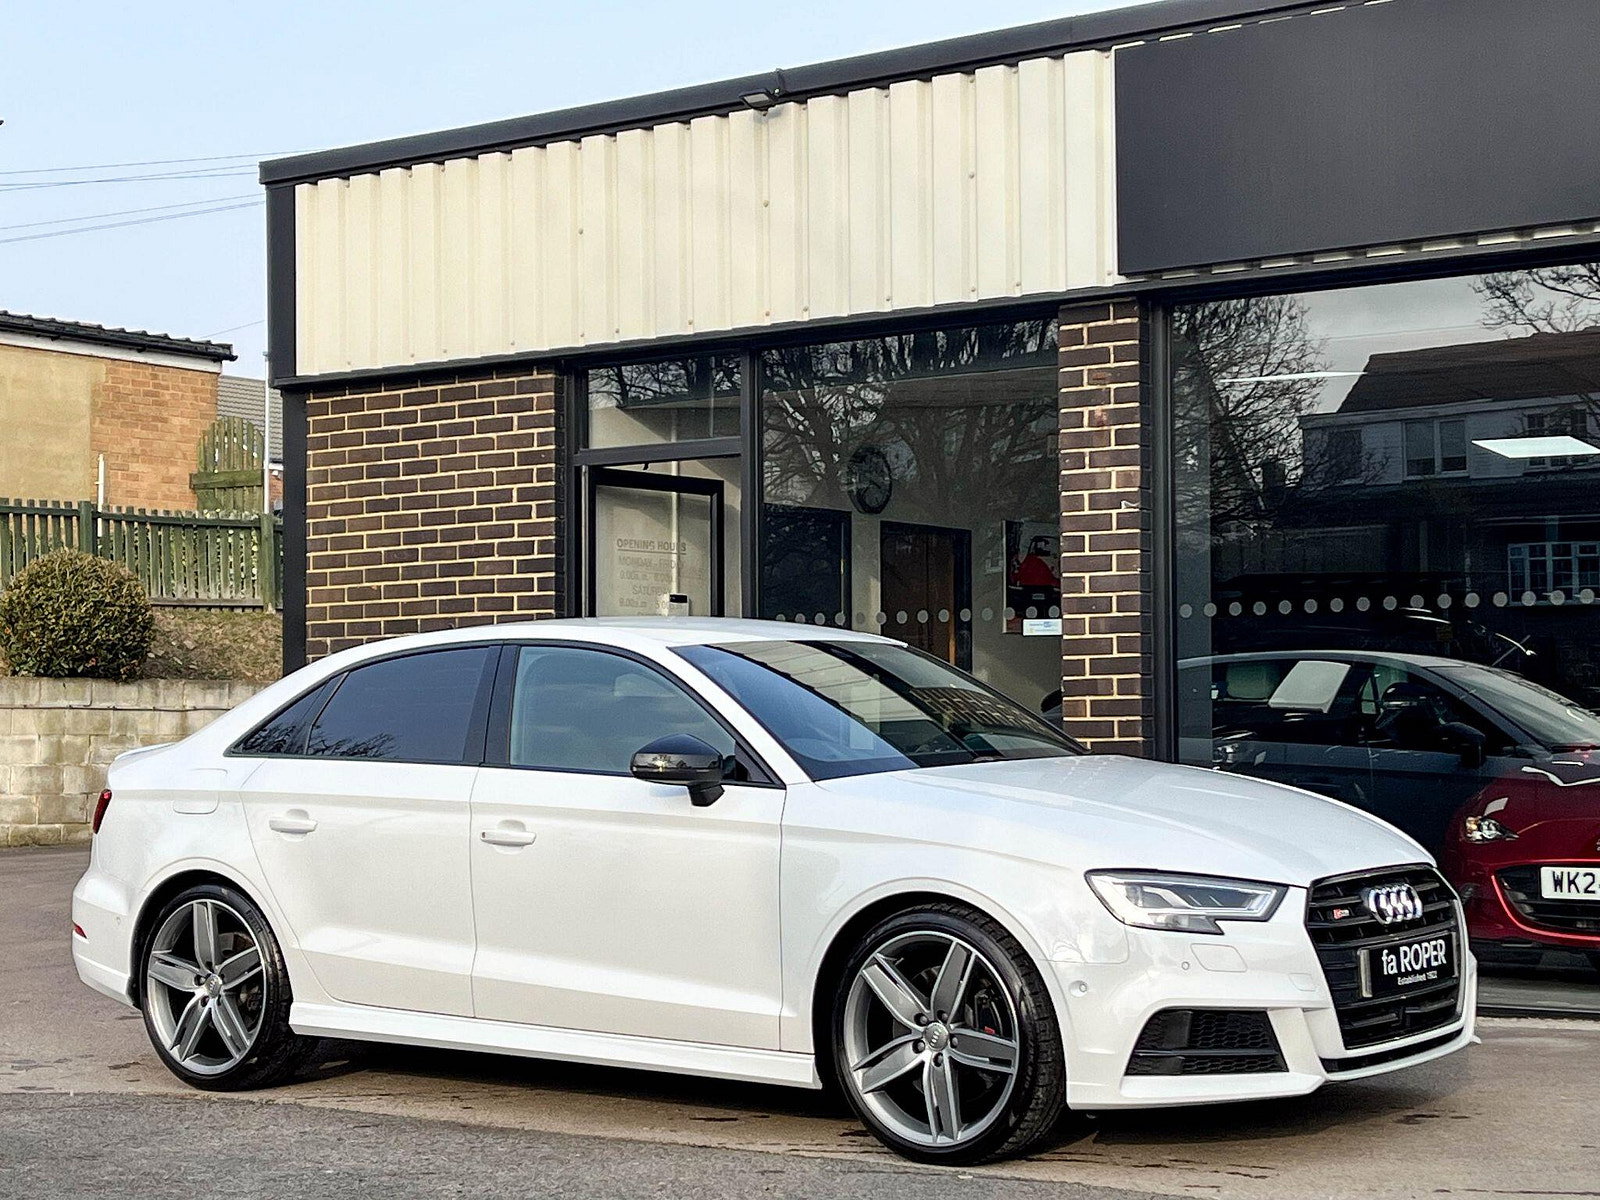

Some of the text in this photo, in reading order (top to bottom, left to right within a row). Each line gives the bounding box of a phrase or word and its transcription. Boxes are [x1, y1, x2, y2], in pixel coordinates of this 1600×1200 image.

[617, 538, 687, 552] OPENING HOUS
[1552, 871, 1600, 894] WK2
[1381, 939, 1447, 975] fa ROPER
